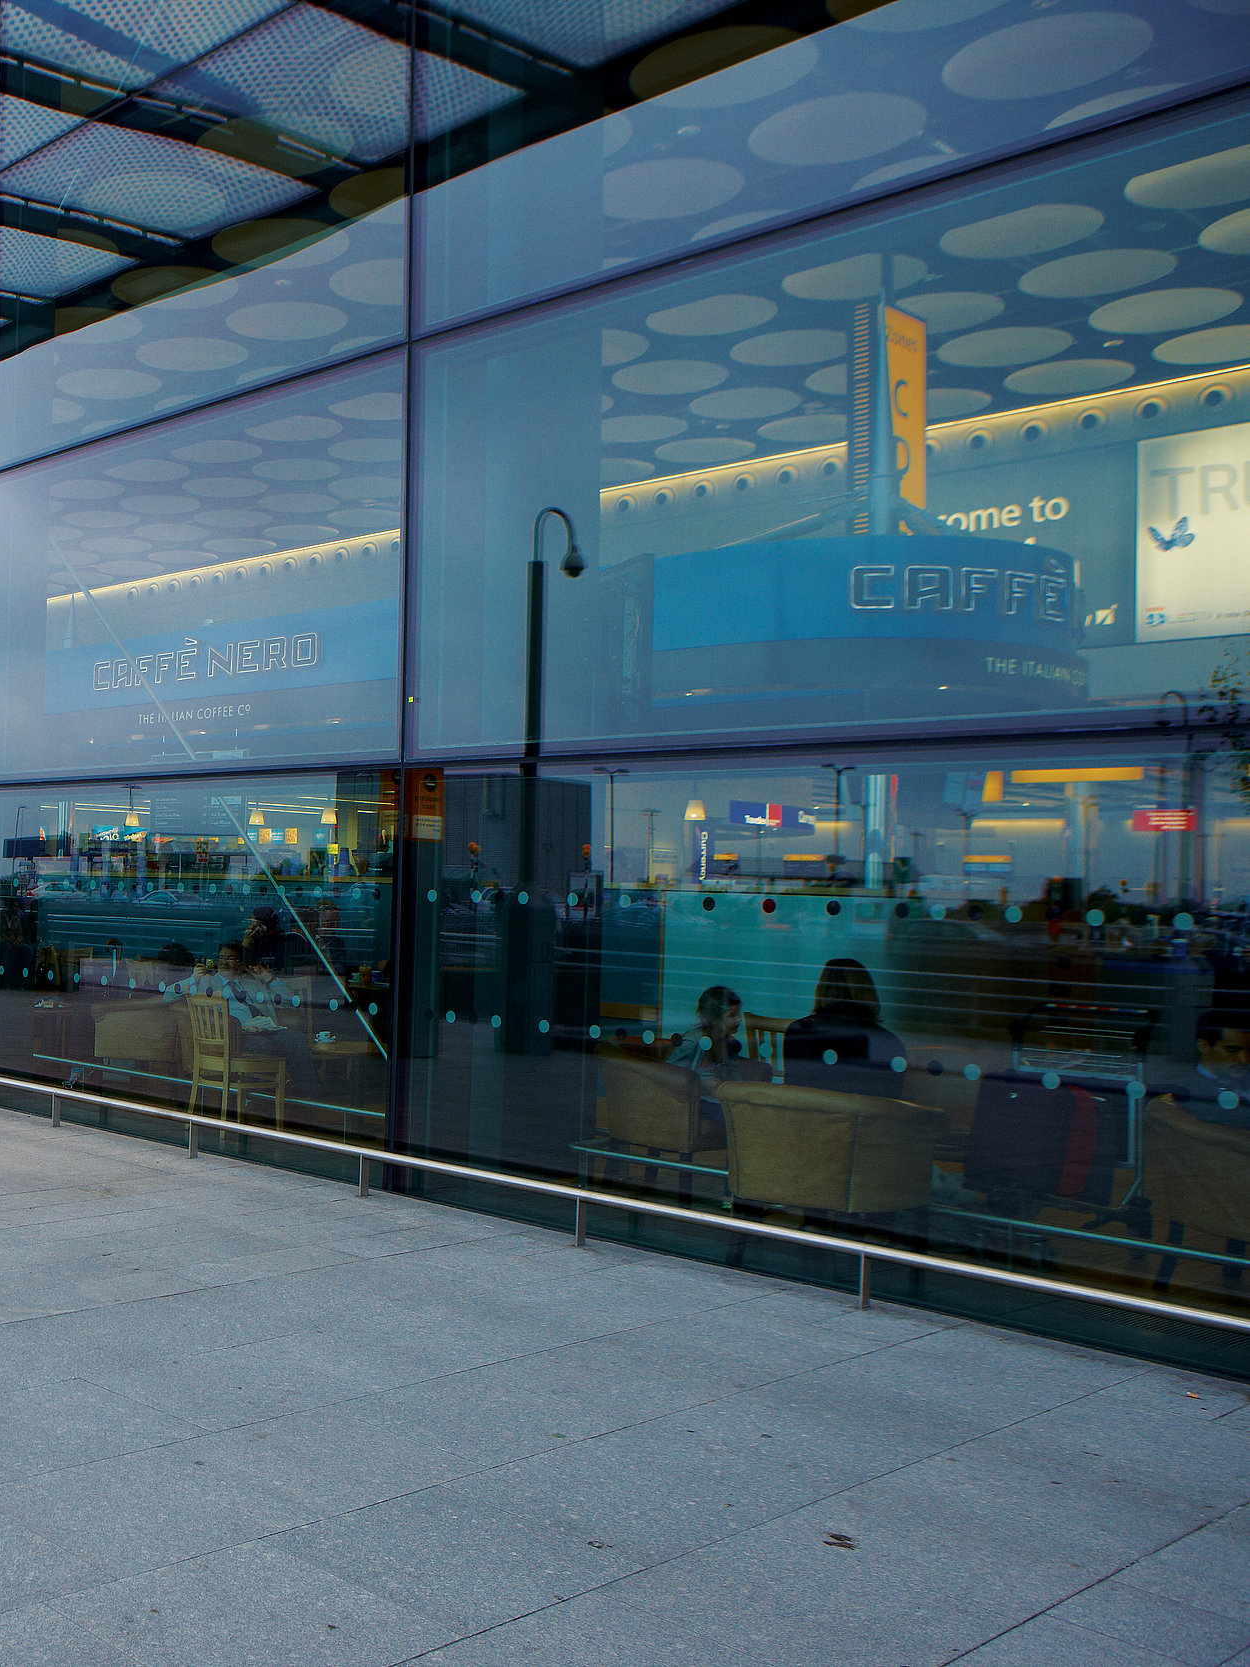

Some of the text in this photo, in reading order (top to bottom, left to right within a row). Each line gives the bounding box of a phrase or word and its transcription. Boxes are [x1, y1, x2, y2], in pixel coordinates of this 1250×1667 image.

[894, 379, 908, 418] C
[1028, 496, 1070, 523] to
[849, 556, 1067, 623] CAFFÈ
[92, 632, 318, 691] CAFFÈ NERO
[985, 657, 1017, 675] THE
[138, 713, 154, 725] THE
[157, 710, 193, 723] ILIAN
[196, 705, 234, 720] COFFEE
[699, 831, 709, 880] Currency
